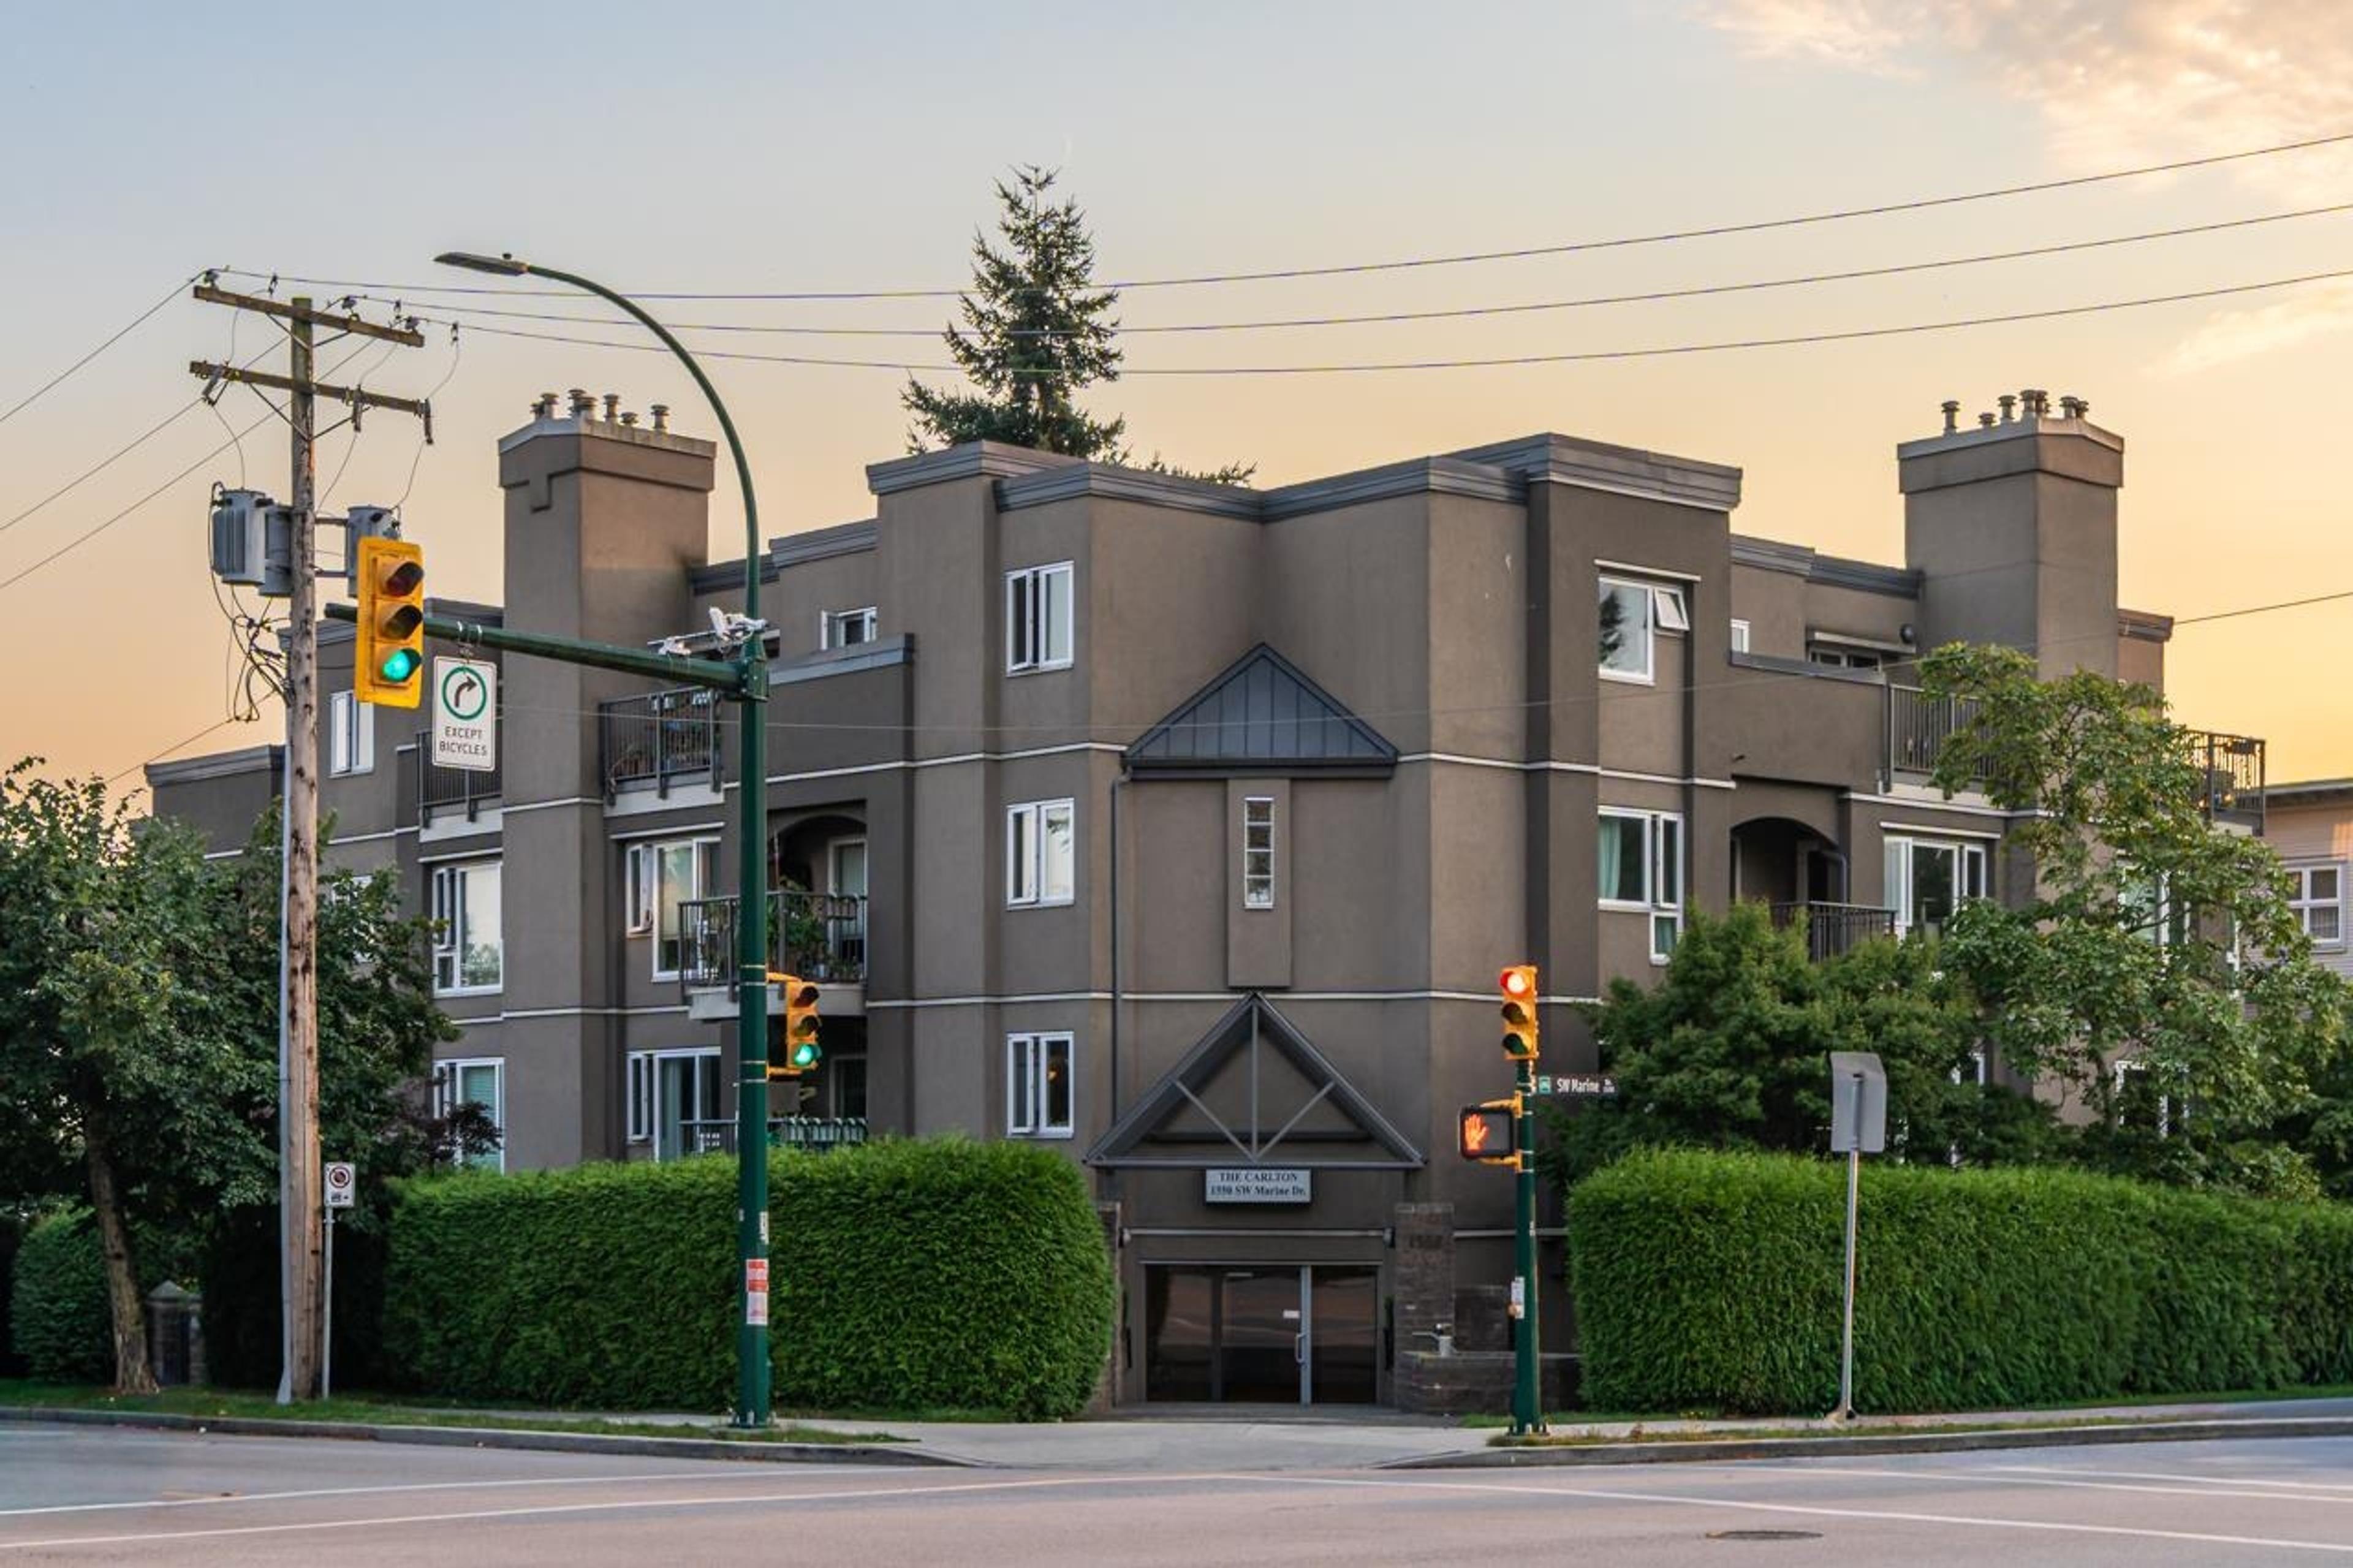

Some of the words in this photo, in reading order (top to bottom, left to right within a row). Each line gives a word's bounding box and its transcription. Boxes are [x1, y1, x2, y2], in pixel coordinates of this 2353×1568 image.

[445, 726, 482, 740] EXCEPT
[439, 741, 487, 756] BICYCLES
[1556, 1078, 1571, 1093] SW
[1572, 1077, 1600, 1093] Marine
[1219, 1172, 1242, 1182] THE
[1245, 1172, 1297, 1183] CARLTON
[1235, 1185, 1252, 1195] SW
[1254, 1185, 1290, 1195] Marine
[1292, 1185, 1306, 1195] Dr.
